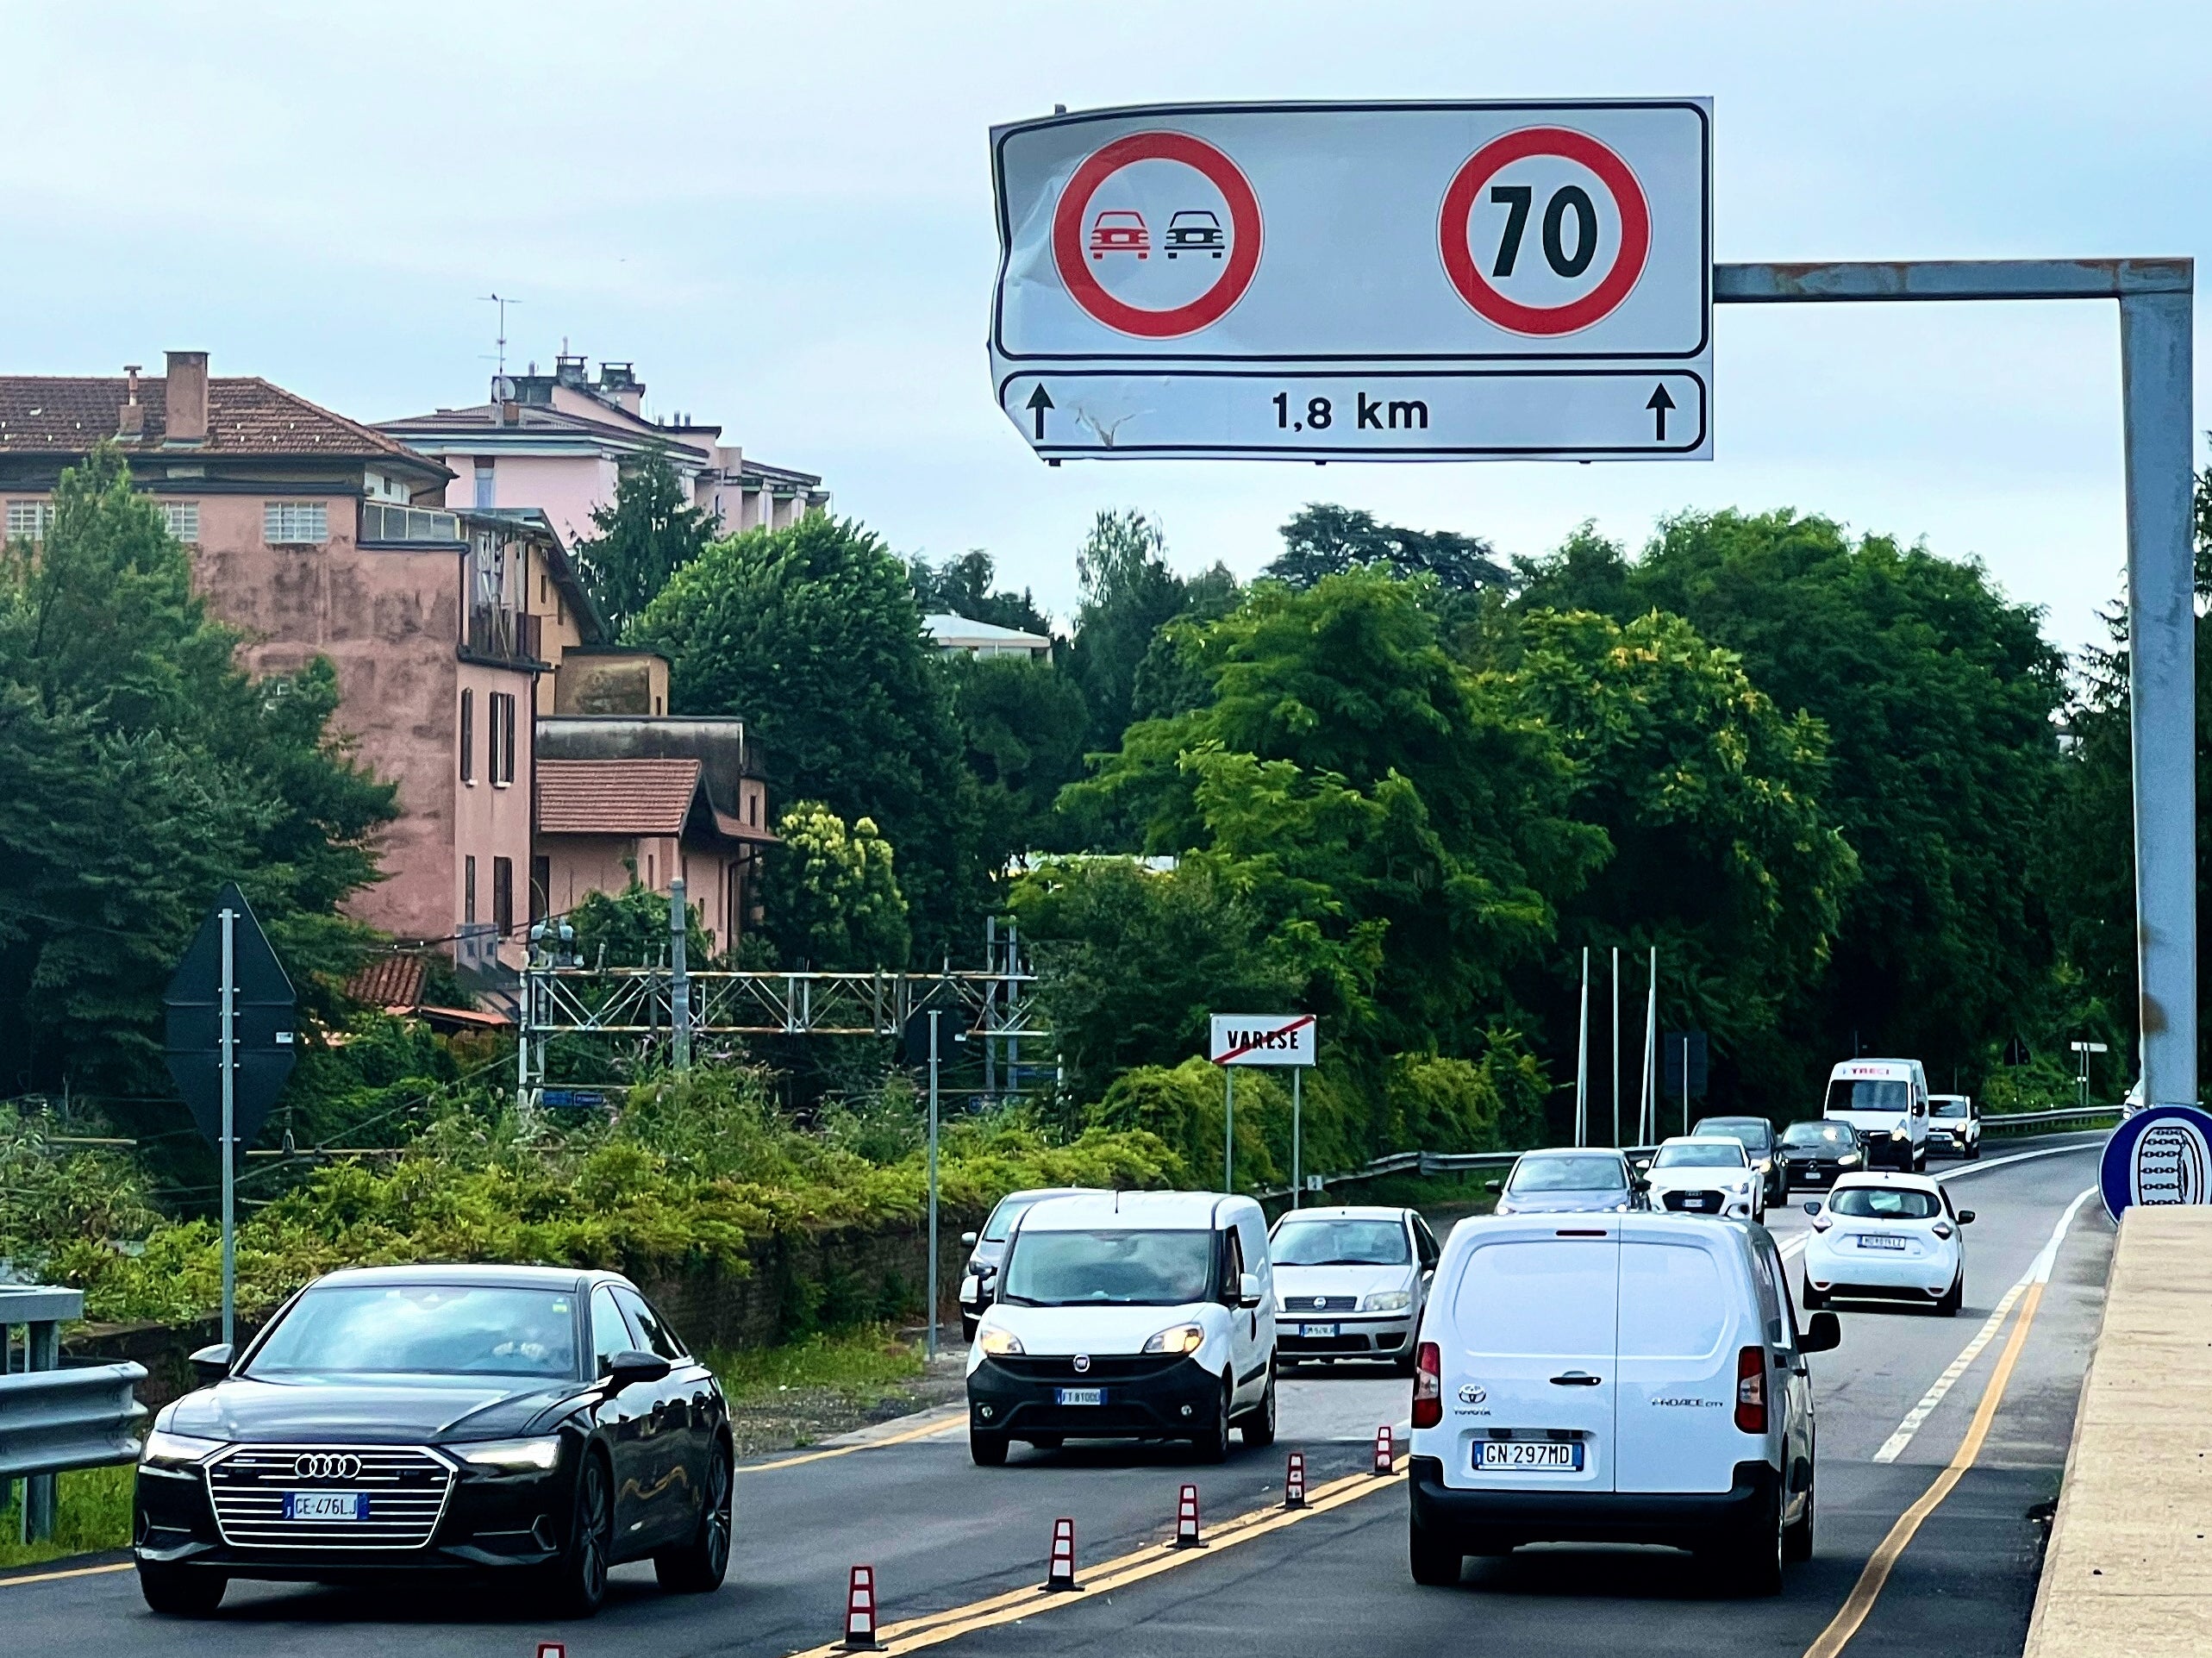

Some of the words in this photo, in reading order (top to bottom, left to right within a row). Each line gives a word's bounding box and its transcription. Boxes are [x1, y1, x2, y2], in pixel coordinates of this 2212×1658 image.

[1490, 185, 1598, 278] 70
[1272, 391, 1332, 433] 1,8
[1358, 391, 1428, 429] km
[1227, 1030, 1299, 1049] VARESE
[1453, 1406, 1491, 1416] TOYOTA
[1486, 1445, 1508, 1463] GN
[1514, 1446, 1570, 1464] 297MD
